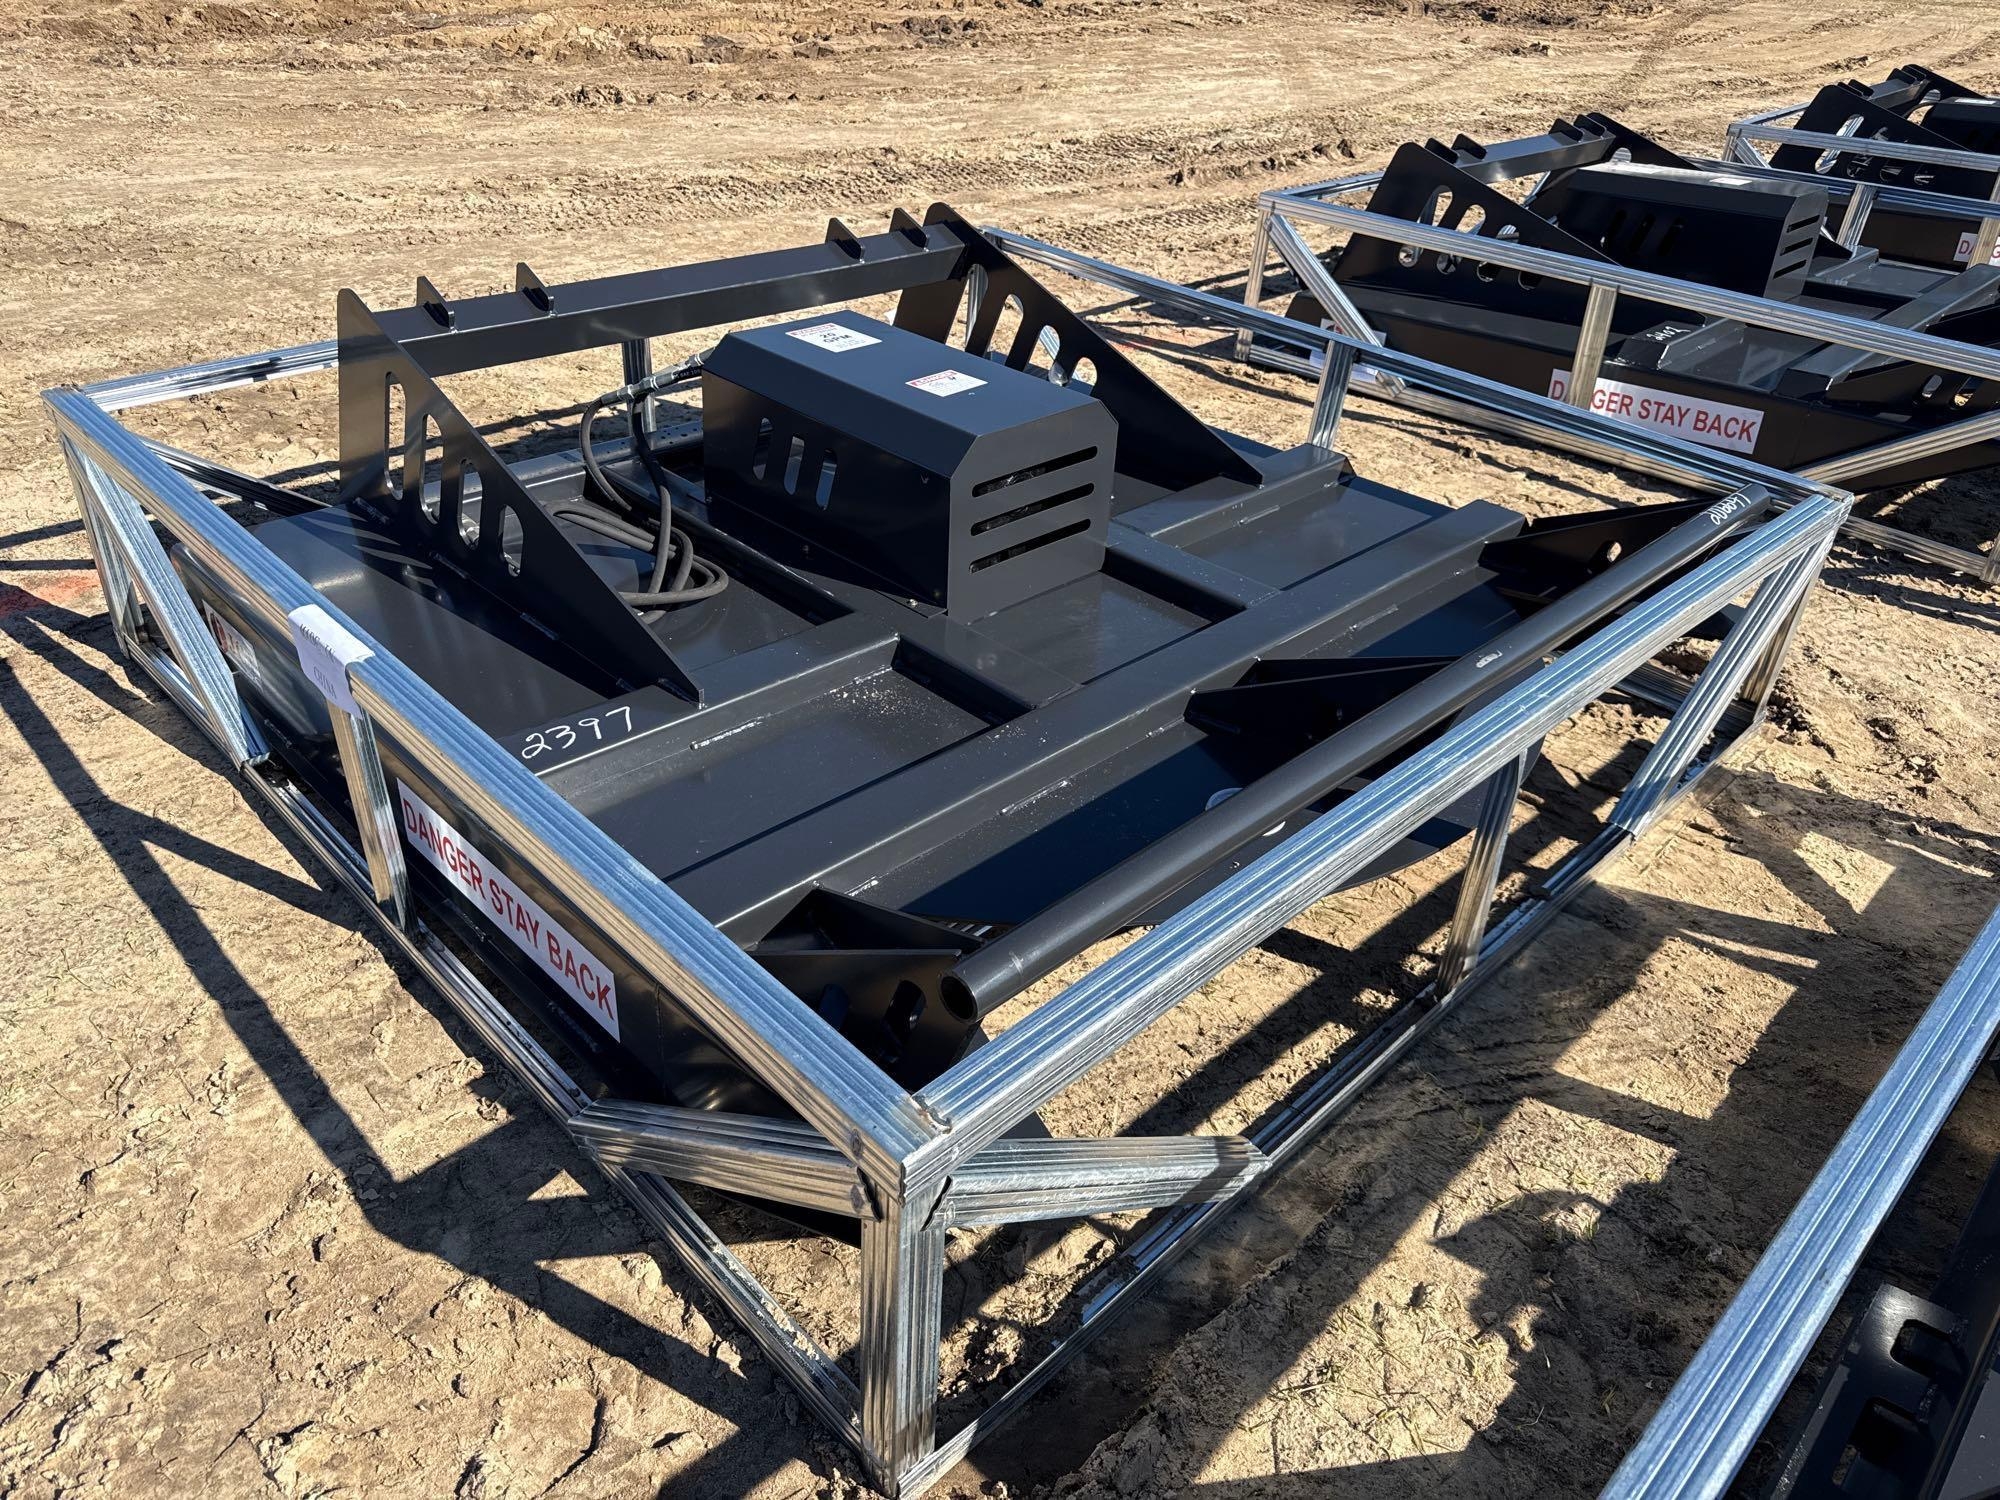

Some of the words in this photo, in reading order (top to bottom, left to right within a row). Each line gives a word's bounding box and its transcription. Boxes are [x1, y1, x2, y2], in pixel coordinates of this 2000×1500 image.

[1551, 380, 1633, 417] DGER
[1638, 398, 1691, 427] STAY
[1693, 410, 1757, 443] BACK
[521, 705, 632, 760] 2397
[403, 797, 486, 901] DANGER
[488, 878, 540, 949] STAY
[546, 930, 615, 1021] BACK
